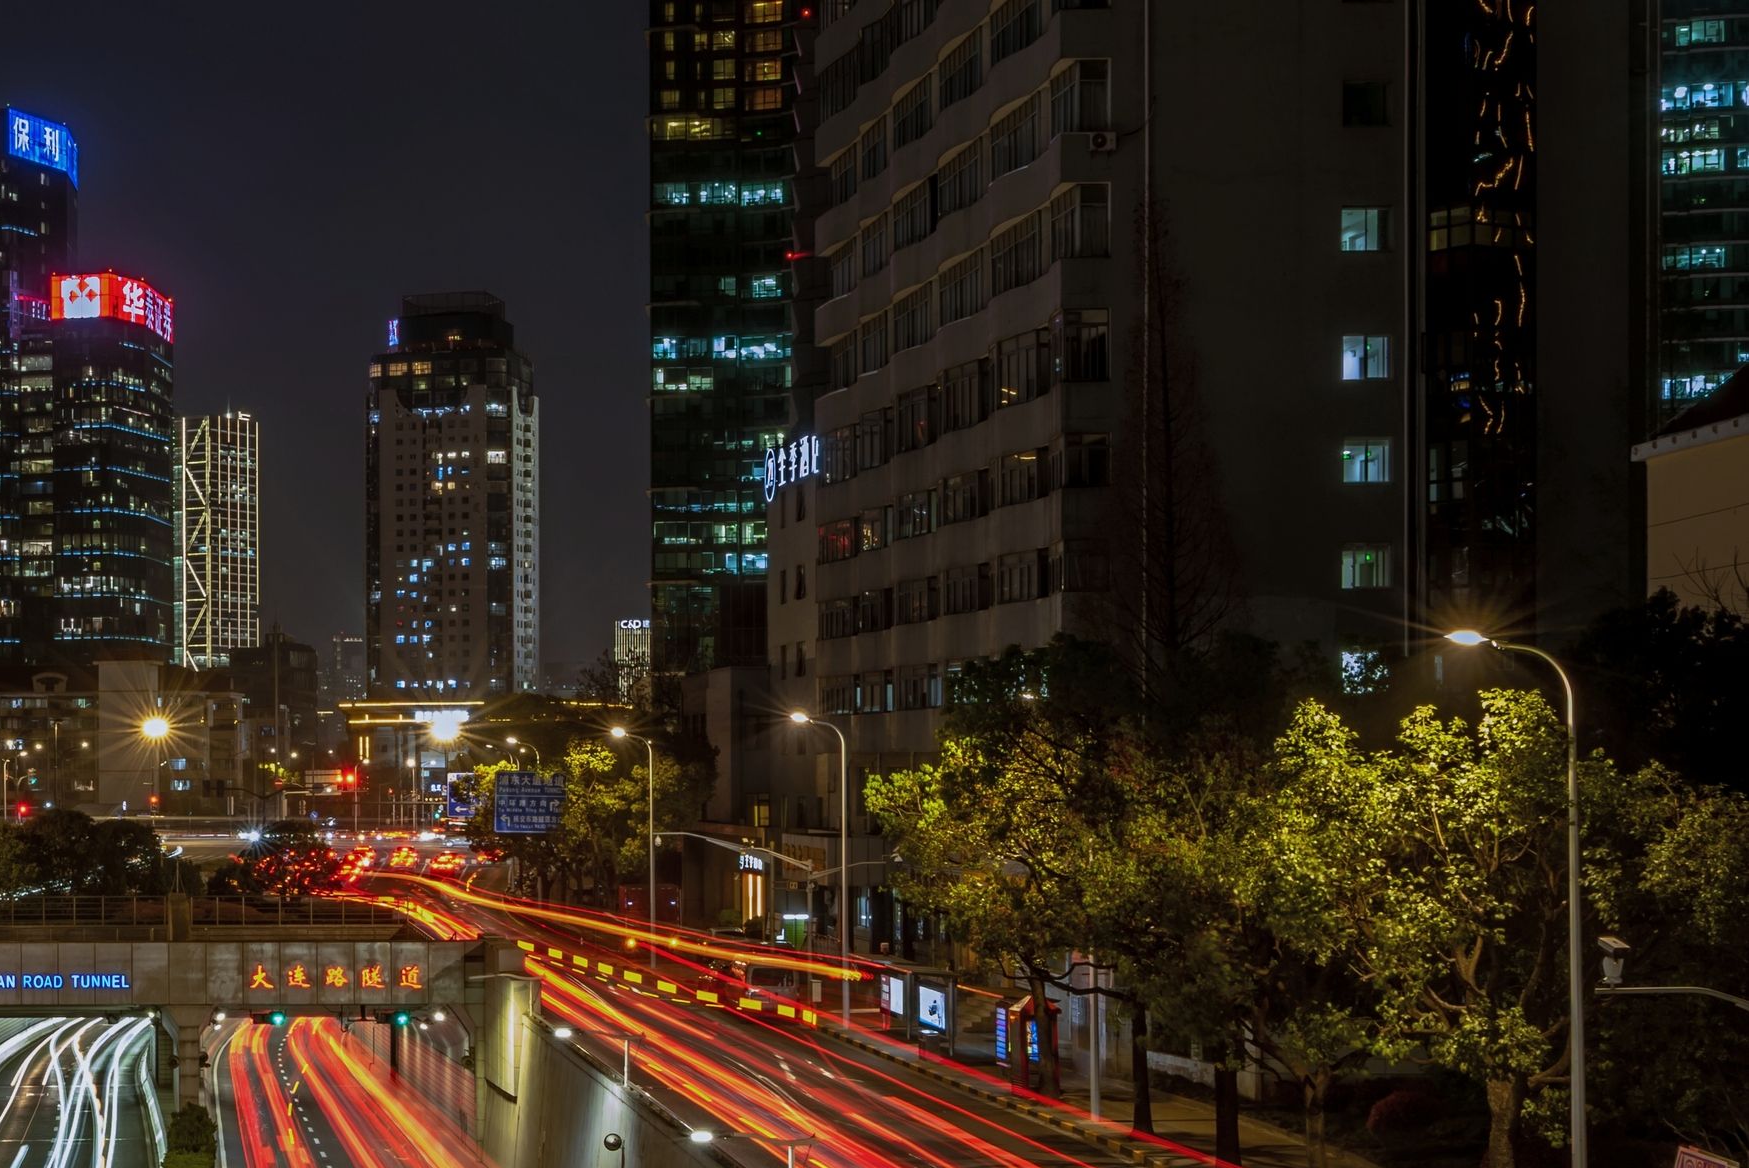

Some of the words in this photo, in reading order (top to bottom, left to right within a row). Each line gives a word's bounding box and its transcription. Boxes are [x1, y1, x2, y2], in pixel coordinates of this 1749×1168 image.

[13, 116, 60, 162] 保利
[620, 619, 642, 630] C&D
[22, 974, 63, 989] ROAD
[71, 974, 130, 989] TUNNEL
[250, 964, 422, 989] 大连路隧道
